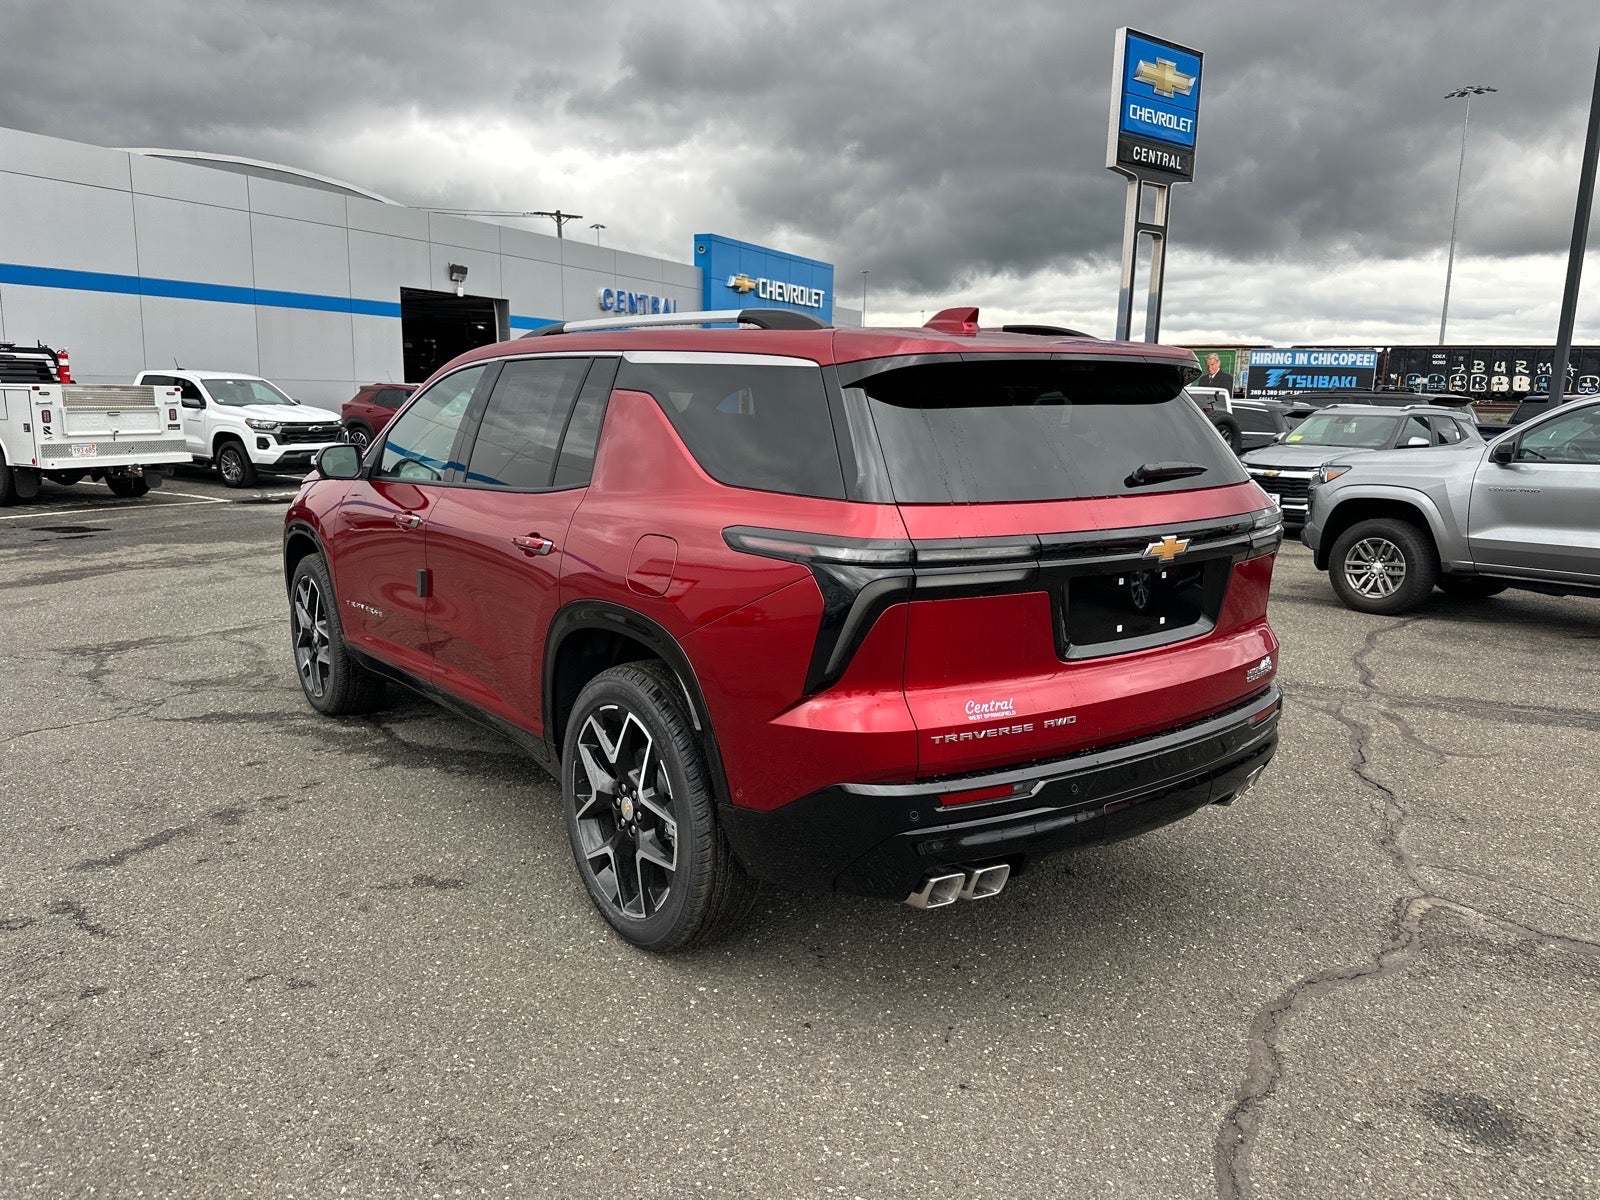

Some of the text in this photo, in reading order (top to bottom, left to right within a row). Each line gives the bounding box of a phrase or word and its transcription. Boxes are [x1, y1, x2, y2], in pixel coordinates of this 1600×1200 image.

[1129, 104, 1193, 133] CHEVROLET
[1133, 146, 1182, 170] CENTRAL
[757, 278, 825, 309] CHEVROLET
[1251, 352, 1375, 366] HIRING IN CHICOPEE!
[1284, 375, 1358, 388] TSUBAKI
[965, 697, 1014, 715] Central
[983, 710, 1017, 719] SPRINGFIELD
[931, 715, 1077, 745] TRAVERSE AWD
